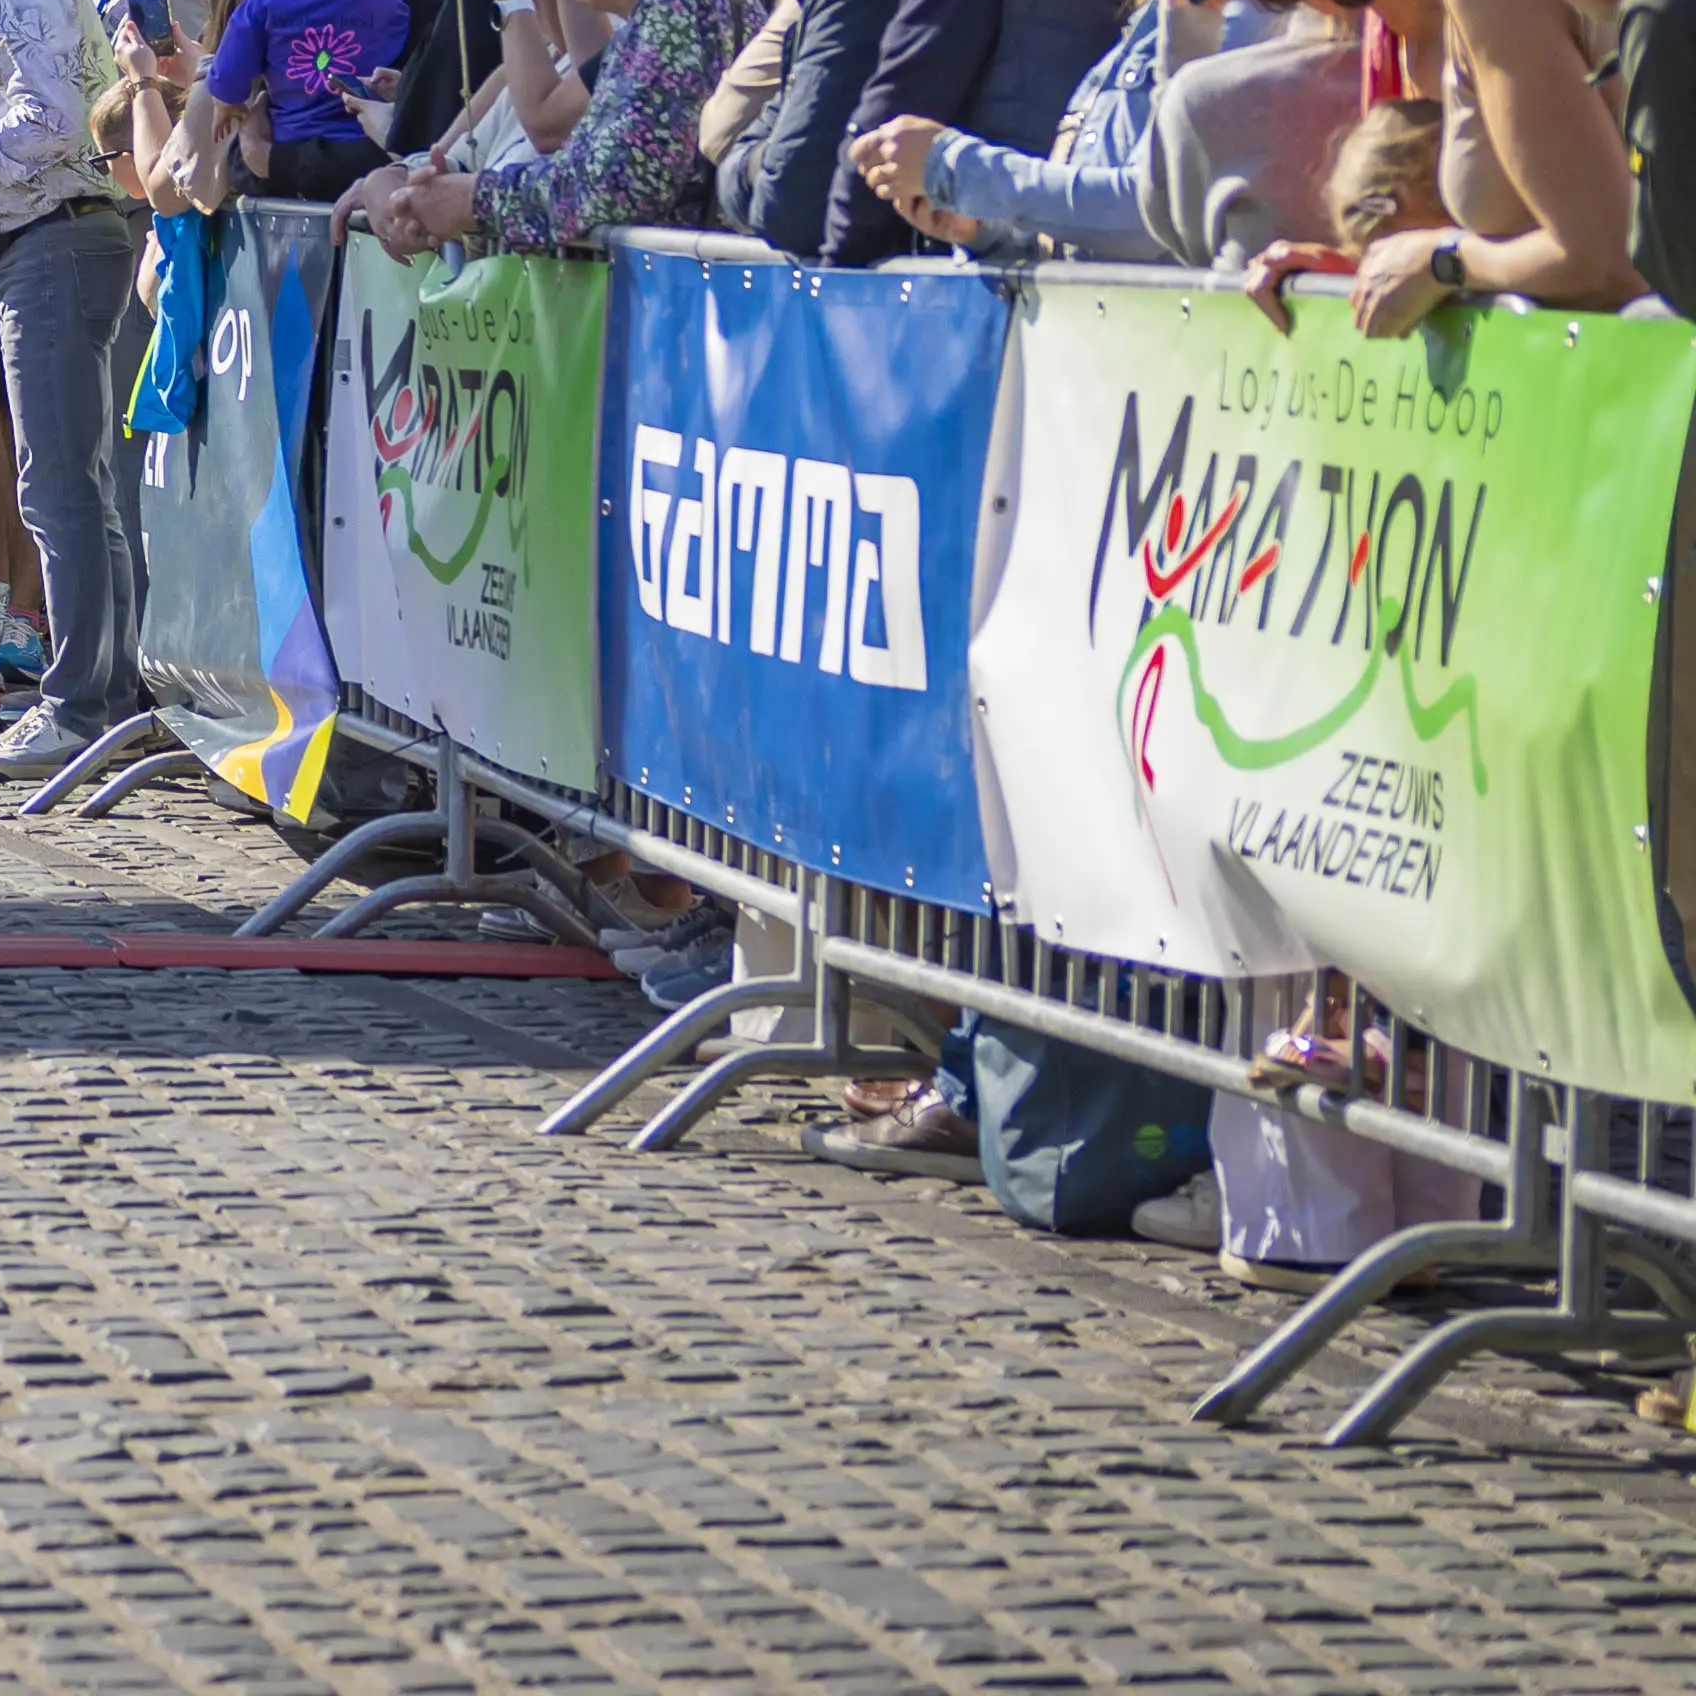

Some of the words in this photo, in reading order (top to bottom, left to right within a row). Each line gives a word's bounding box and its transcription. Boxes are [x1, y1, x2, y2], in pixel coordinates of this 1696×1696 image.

[1395, 363, 1504, 456] Hoop
[1089, 390, 1487, 668] MARATHON
[1323, 751, 1445, 832] ZEEUWS
[1227, 797, 1444, 902] VLAANDEREN
